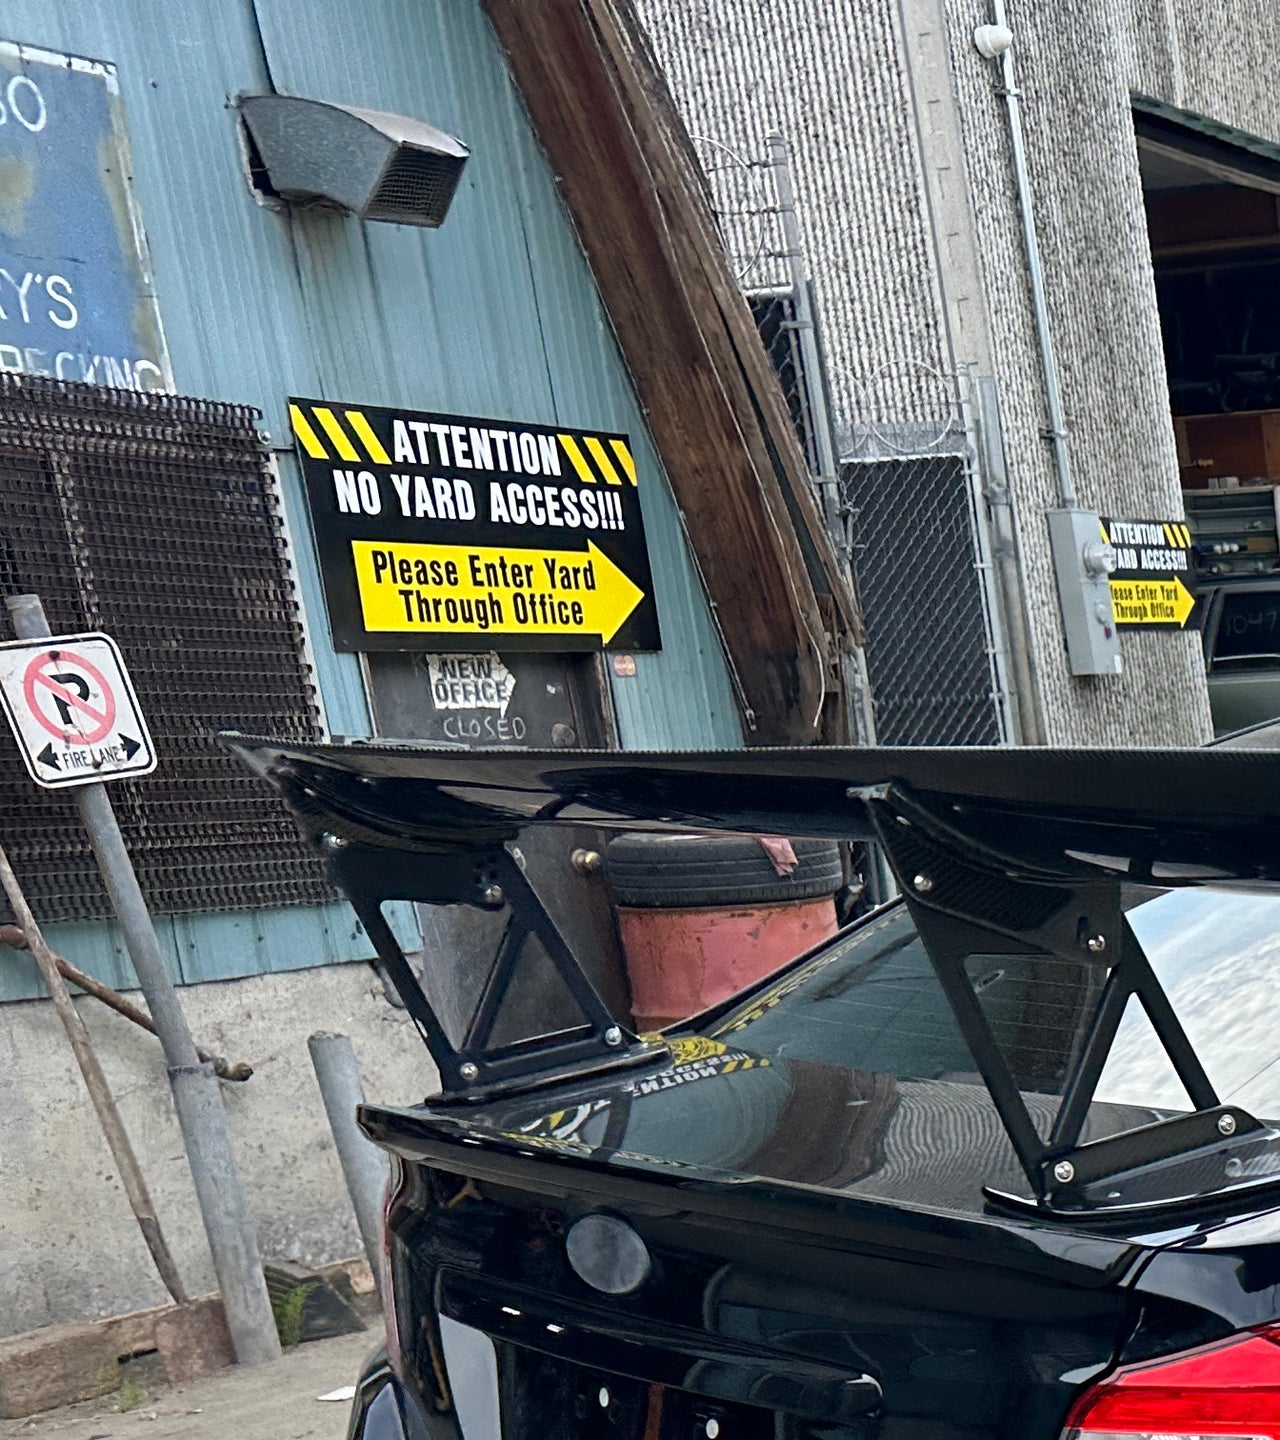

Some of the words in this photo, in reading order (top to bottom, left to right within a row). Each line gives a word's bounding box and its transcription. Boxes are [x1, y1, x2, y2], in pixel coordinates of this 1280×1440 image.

[393, 419, 562, 477] ATTENTION
[332, 469, 382, 516] NO
[391, 473, 476, 521] YARD
[490, 481, 625, 531] ACCESS!!!
[1109, 522, 1165, 546] ATTENTION
[371, 550, 459, 587] Please
[468, 555, 534, 589] Enter
[543, 558, 597, 591] Yard
[1141, 549, 1188, 571] ACCESS!!!
[1110, 585, 1133, 601] lease
[1135, 585, 1158, 601] Enter
[1159, 585, 1179, 601] Yard
[399, 589, 504, 629] Through
[514, 593, 584, 626] Office
[1115, 602, 1148, 621] Through
[1150, 602, 1175, 618] Office
[438, 656, 493, 680] NEW
[434, 678, 508, 703] OFFICE
[443, 715, 527, 740] CLOSED
[62, 751, 90, 769] FIRE
[91, 746, 121, 768] LANE
